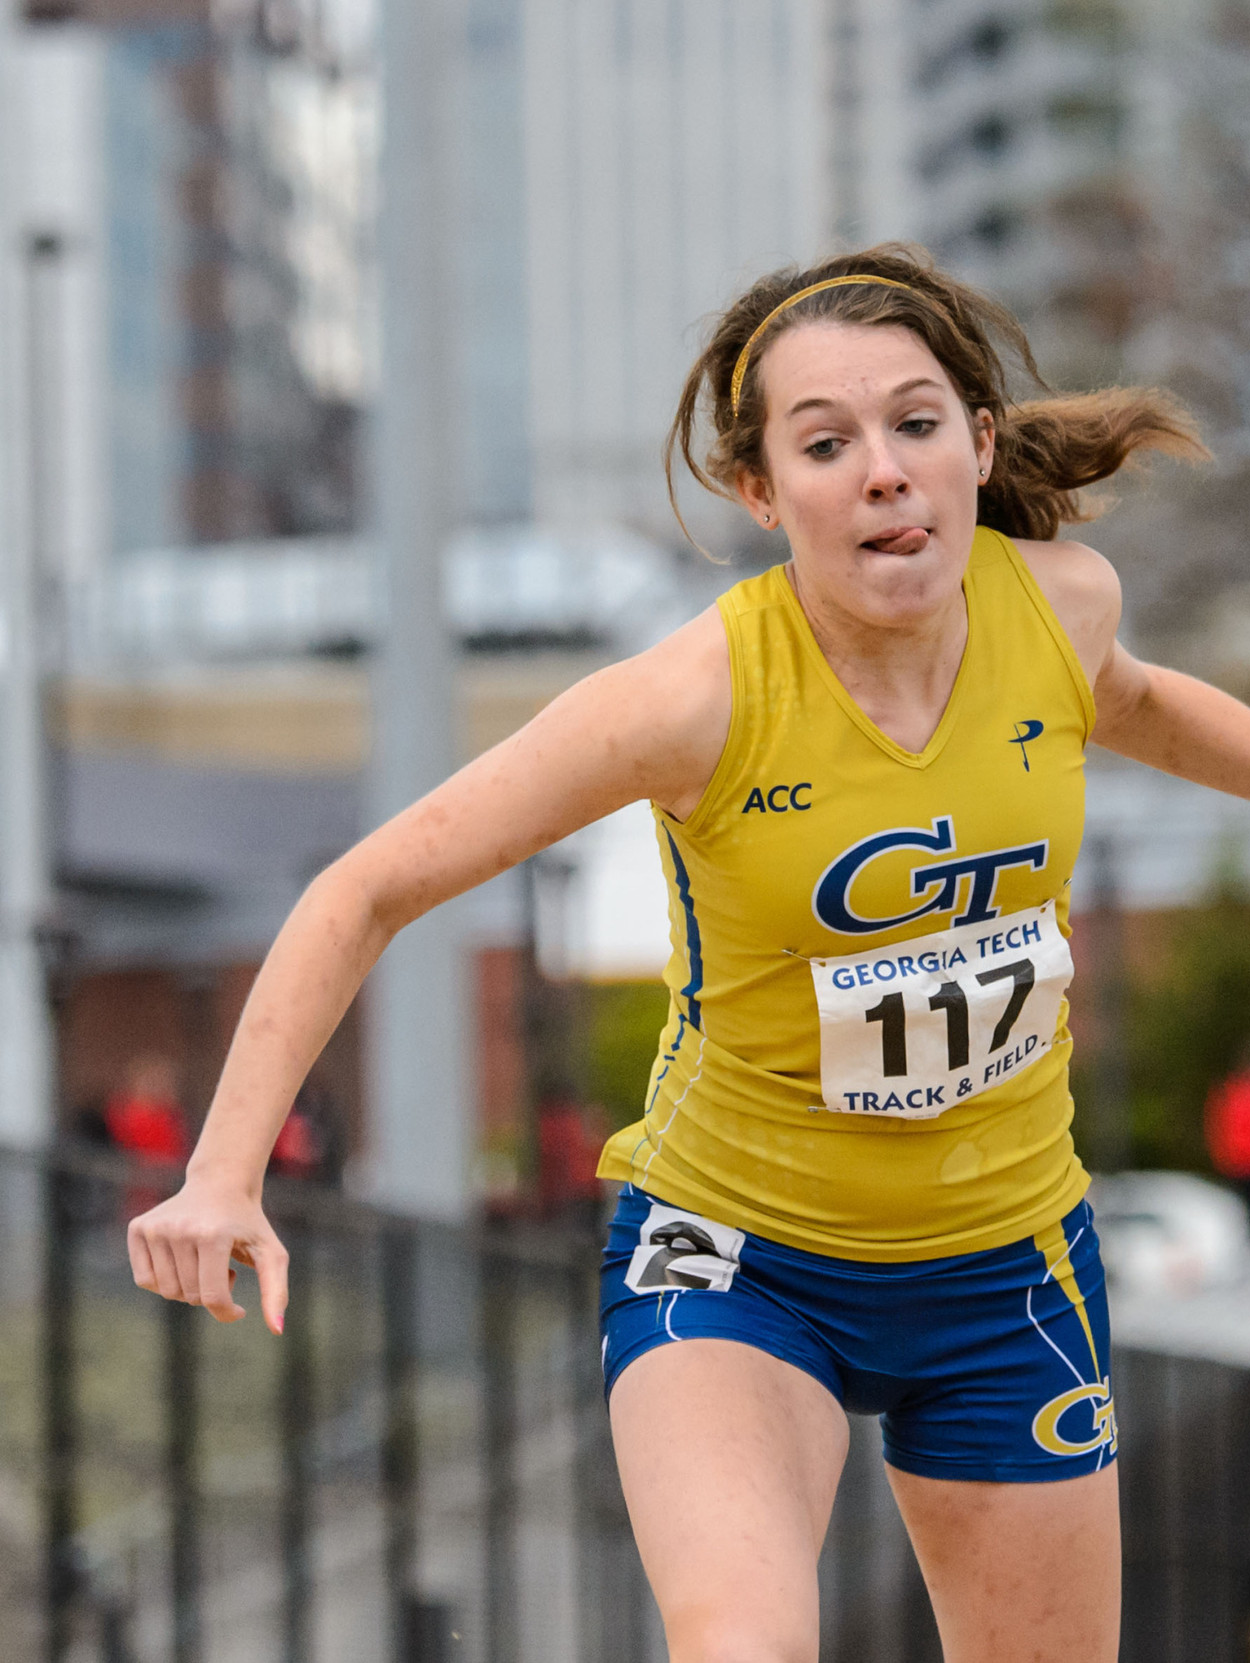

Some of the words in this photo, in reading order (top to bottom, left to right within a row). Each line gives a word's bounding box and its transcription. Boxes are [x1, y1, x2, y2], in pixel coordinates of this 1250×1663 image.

[742, 783, 812, 813] ACC
[811, 815, 1049, 936] GT
[832, 947, 968, 990] GEORGIA
[976, 920, 1042, 957] TECH
[865, 958, 1034, 1078] 117
[843, 1086, 945, 1111] TRACK
[956, 1078, 973, 1097] &
[983, 1034, 1038, 1084] FIELD
